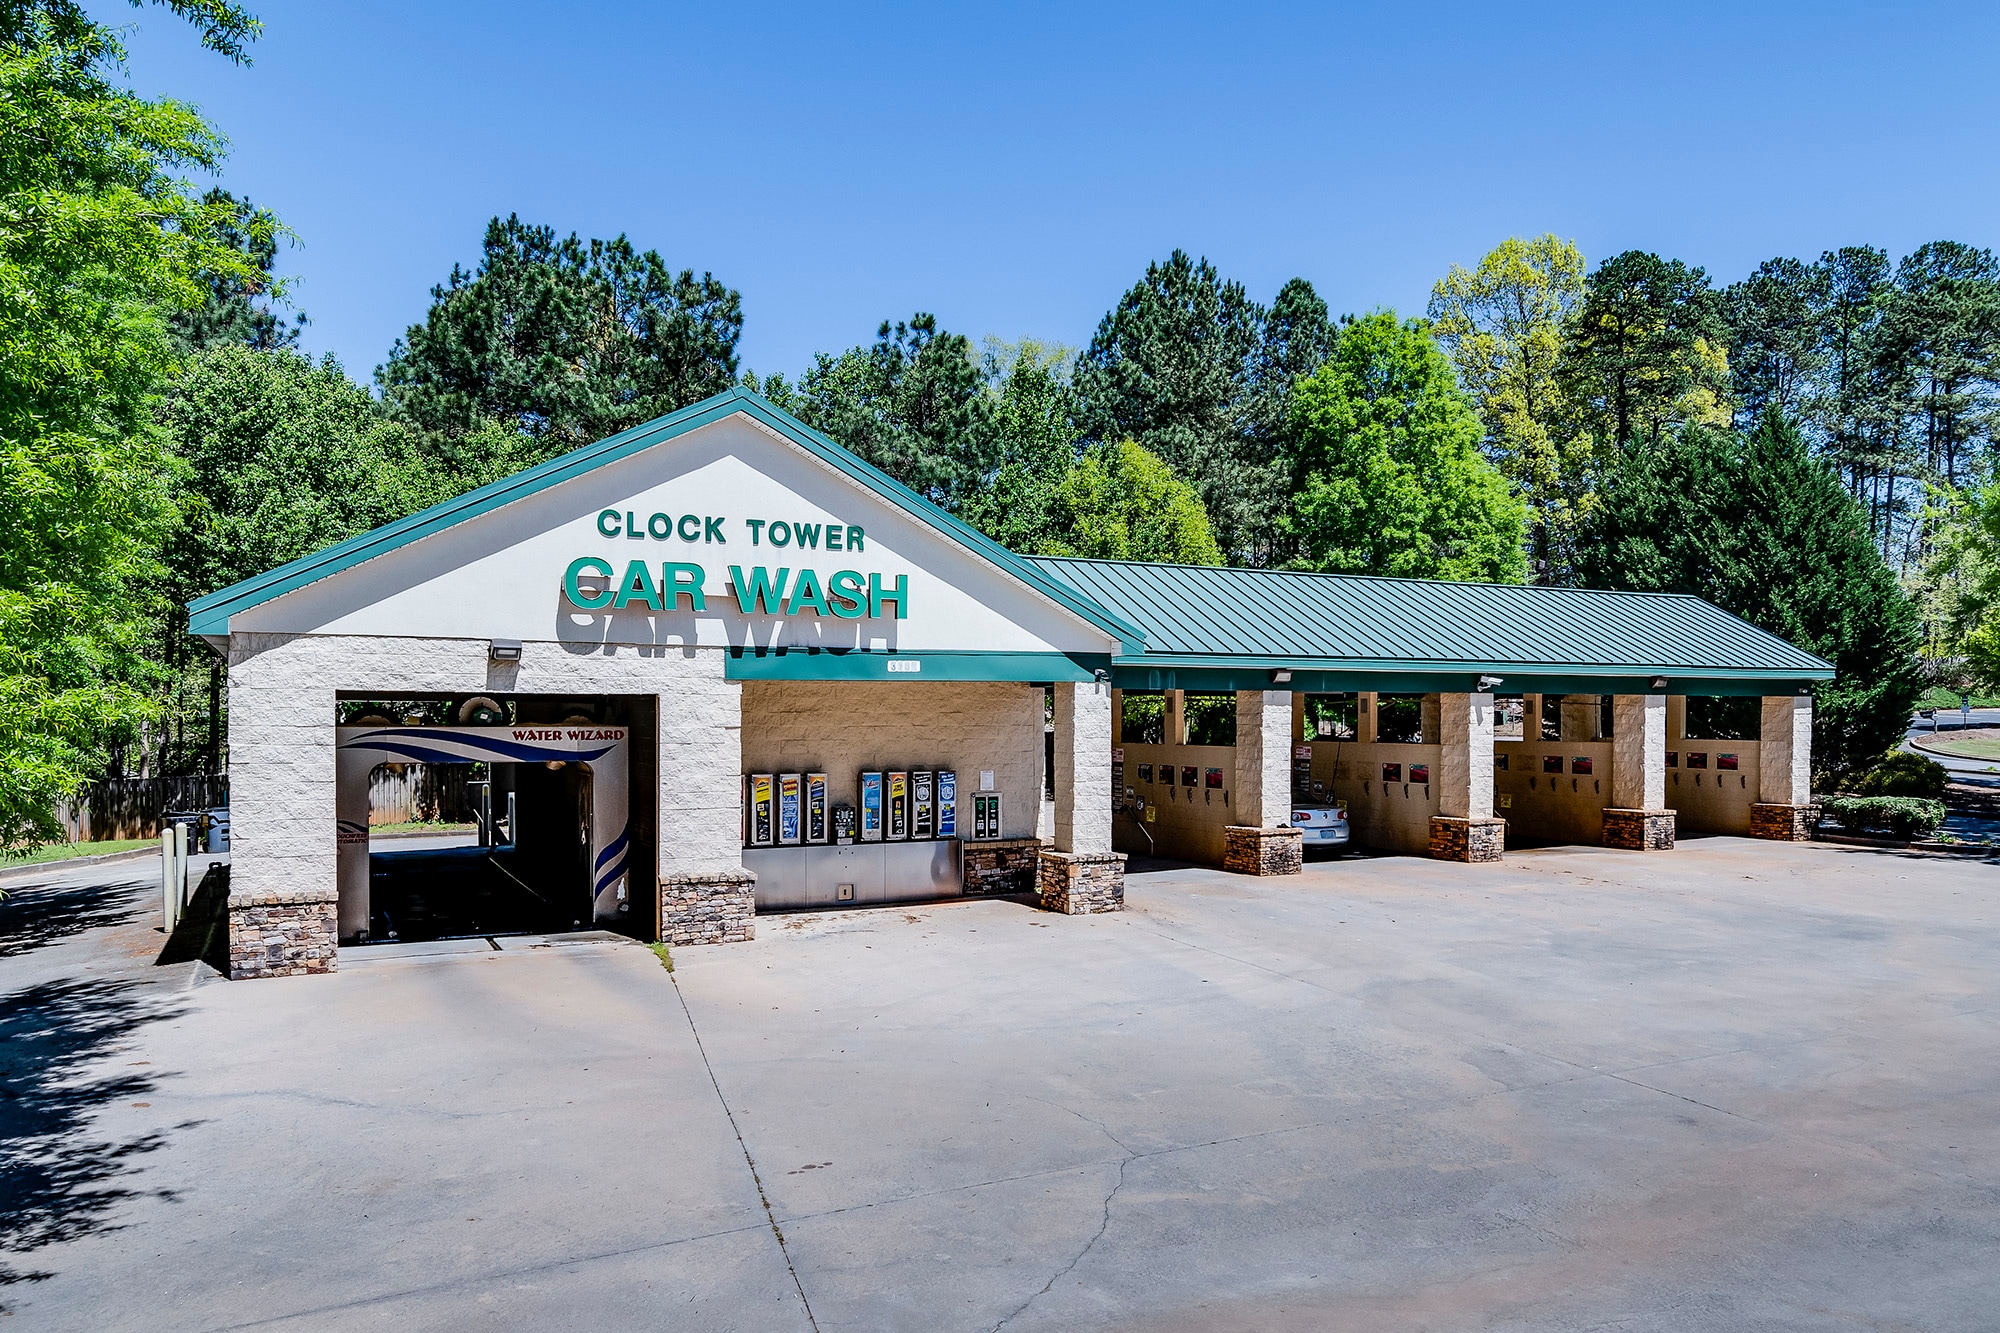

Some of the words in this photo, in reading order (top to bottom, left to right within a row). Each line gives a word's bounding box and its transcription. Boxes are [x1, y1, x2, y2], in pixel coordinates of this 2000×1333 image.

[597, 509, 726, 544] CLOCK
[746, 519, 865, 552] TOWER
[563, 556, 707, 611] CAR
[728, 564, 908, 619] WASH
[512, 729, 563, 741] WATER
[567, 730, 625, 741] WIZARD
